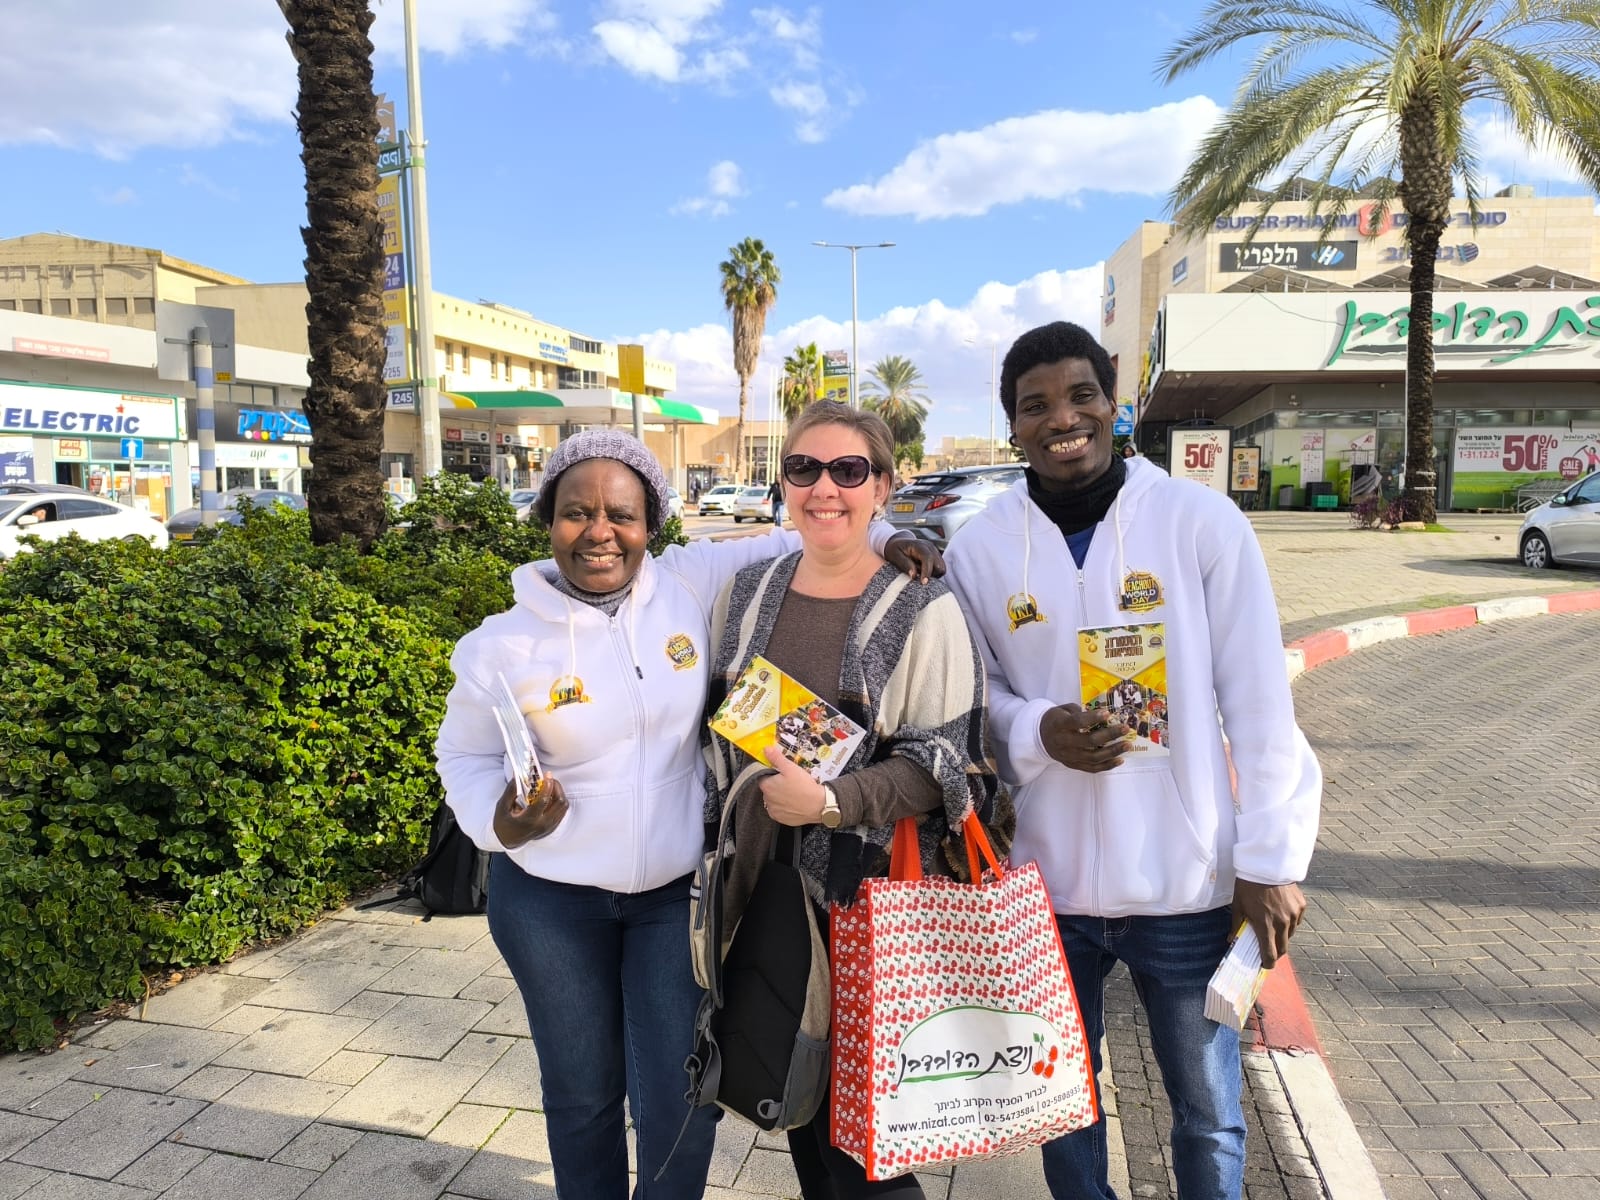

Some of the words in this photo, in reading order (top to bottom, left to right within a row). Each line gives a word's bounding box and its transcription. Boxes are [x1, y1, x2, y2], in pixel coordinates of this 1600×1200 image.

[394, 392, 413, 404] 245
[3, 406, 141, 435] ELECTRIC
[1184, 443, 1222, 469] 50%
[1502, 434, 1558, 472] 50%
[1562, 460, 1580, 470] SALE
[1125, 588, 1156, 599] WORLD
[896, 1050, 980, 1088] הדובדבן
[964, 1045, 1033, 1081] ניצת
[1025, 1085, 1047, 1100] לברור
[934, 1098, 961, 1114] לביתך
[963, 1097, 992, 1109] הקרוב
[995, 1096, 1023, 1109] הסניף
[888, 1114, 975, 1133] www.nizat.com
[984, 1106, 1035, 1123] 02-5473584
